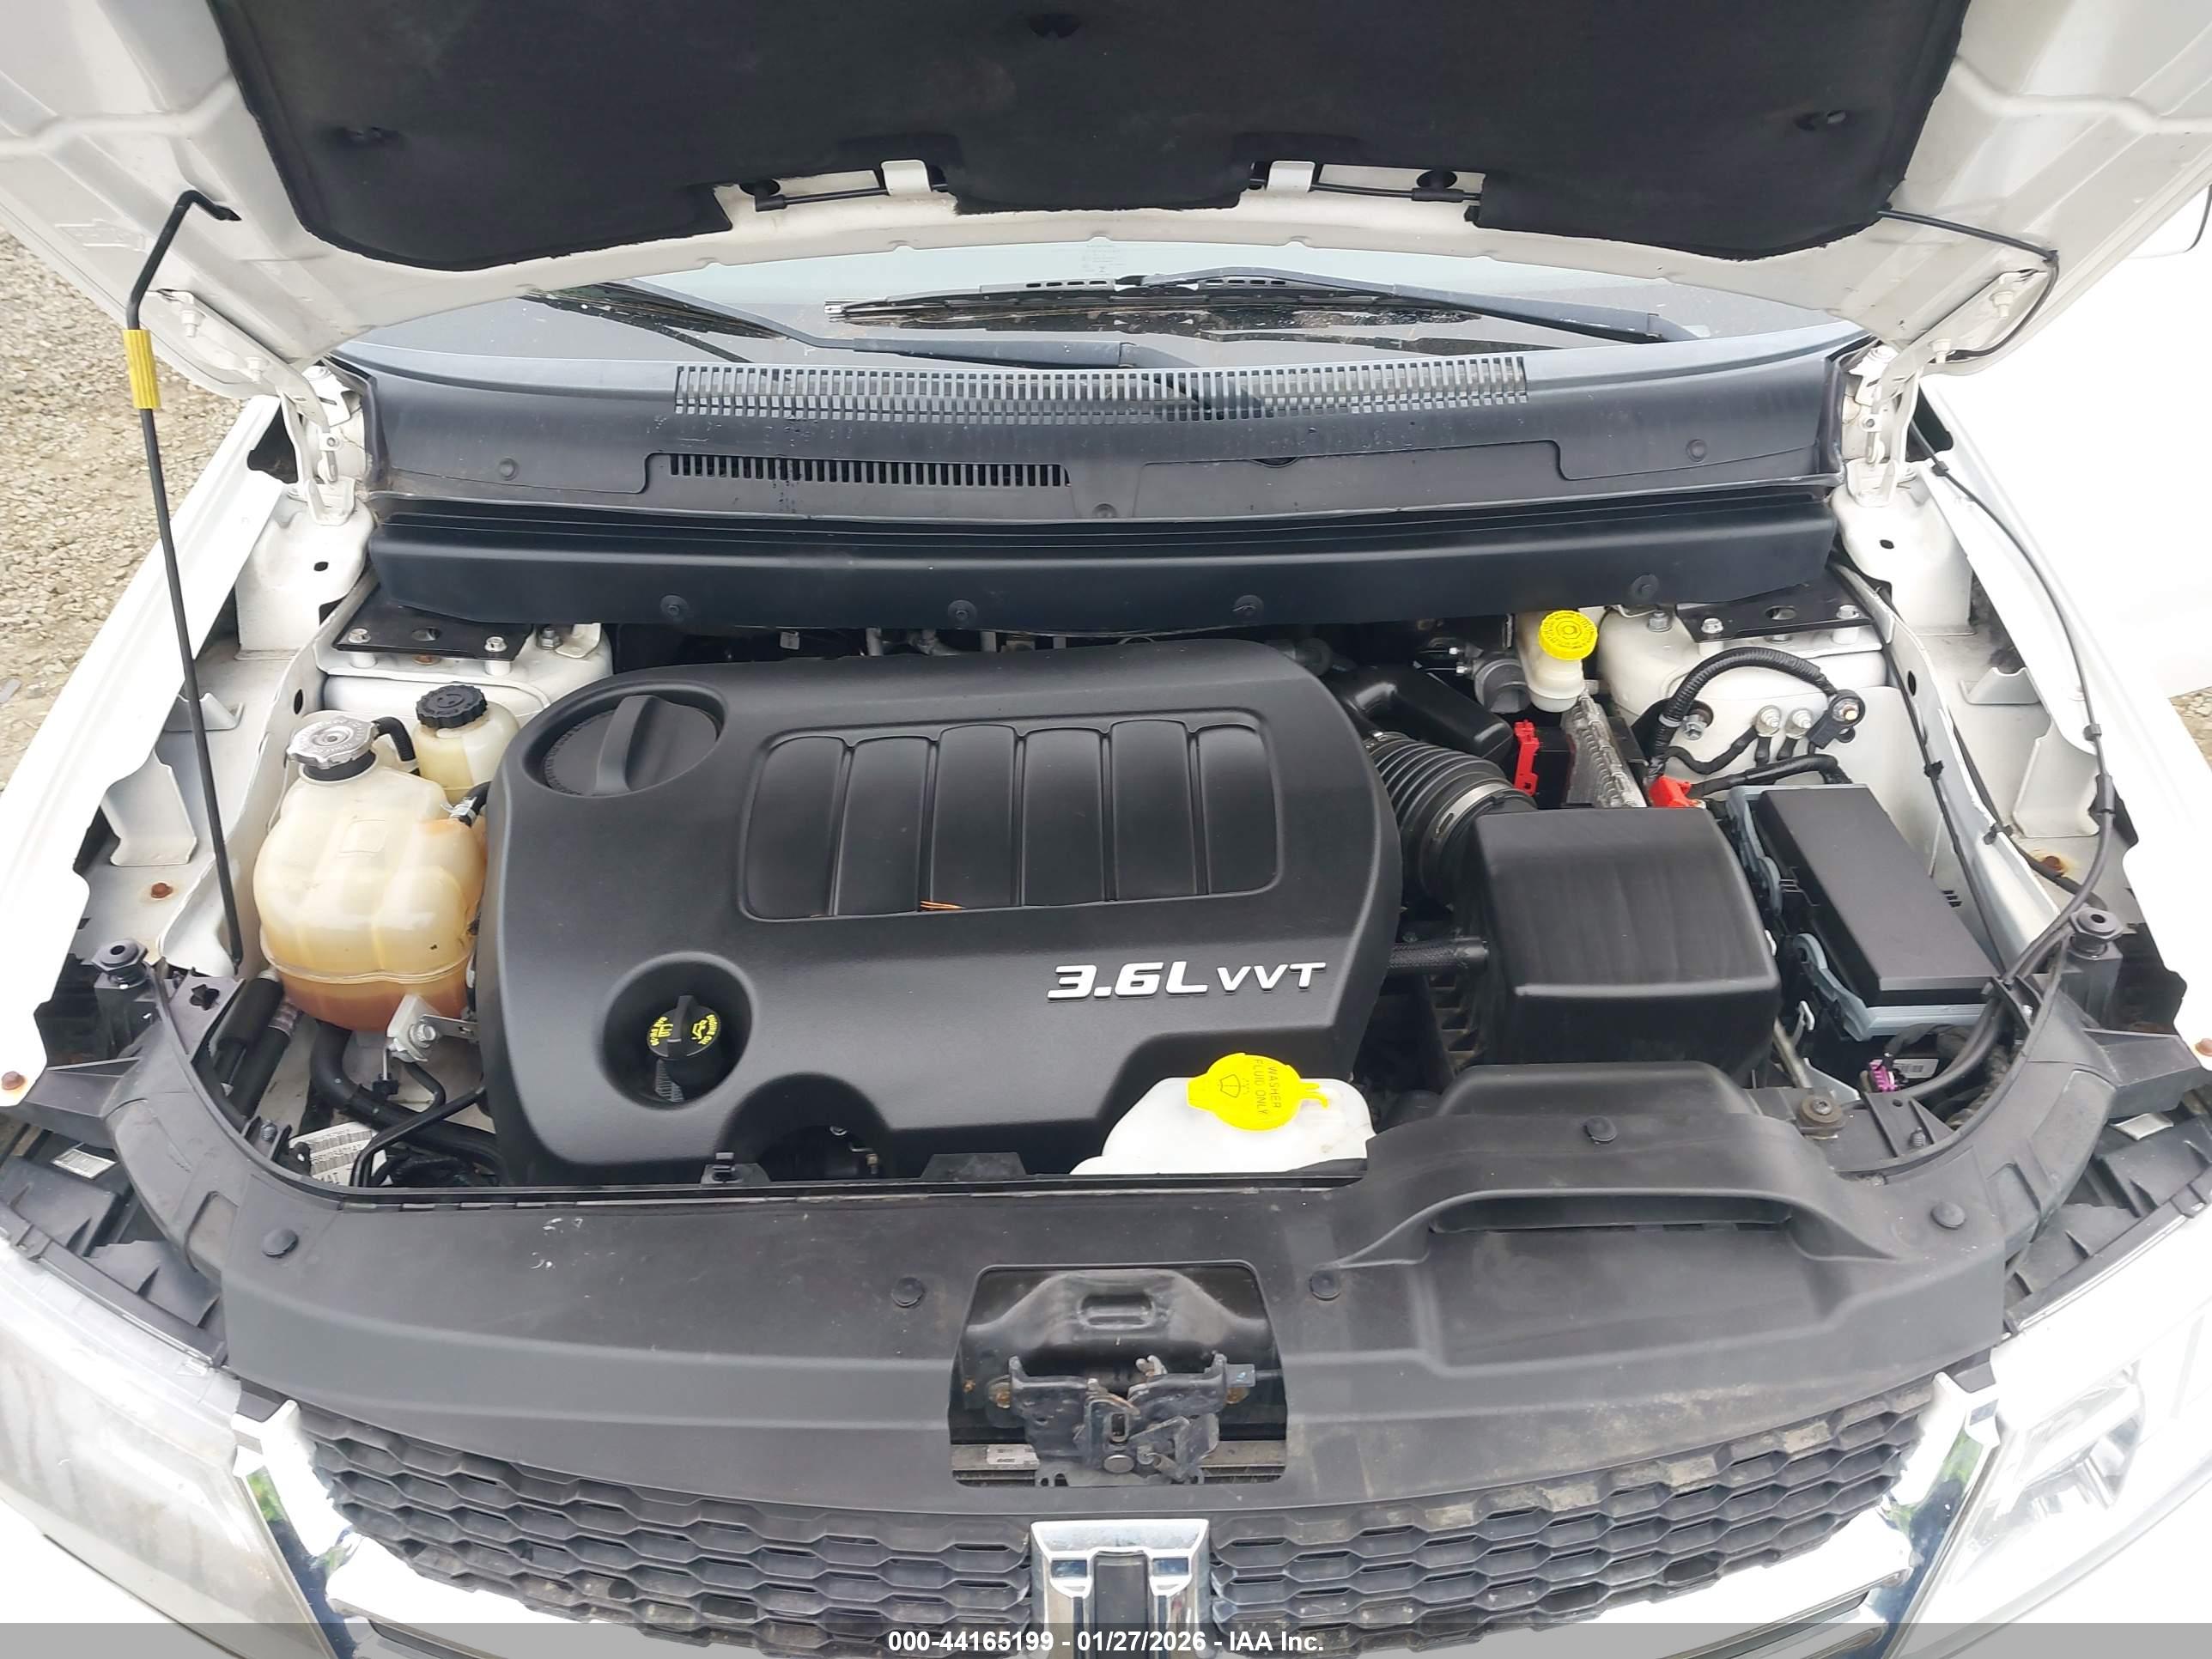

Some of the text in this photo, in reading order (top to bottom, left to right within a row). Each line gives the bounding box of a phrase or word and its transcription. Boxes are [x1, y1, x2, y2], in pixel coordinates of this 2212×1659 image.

[1047, 961, 1327, 1000] 3.6L VVT
[1253, 1059, 1268, 1115] FLUID ONLY
[1267, 1066, 1282, 1109] WASHER
